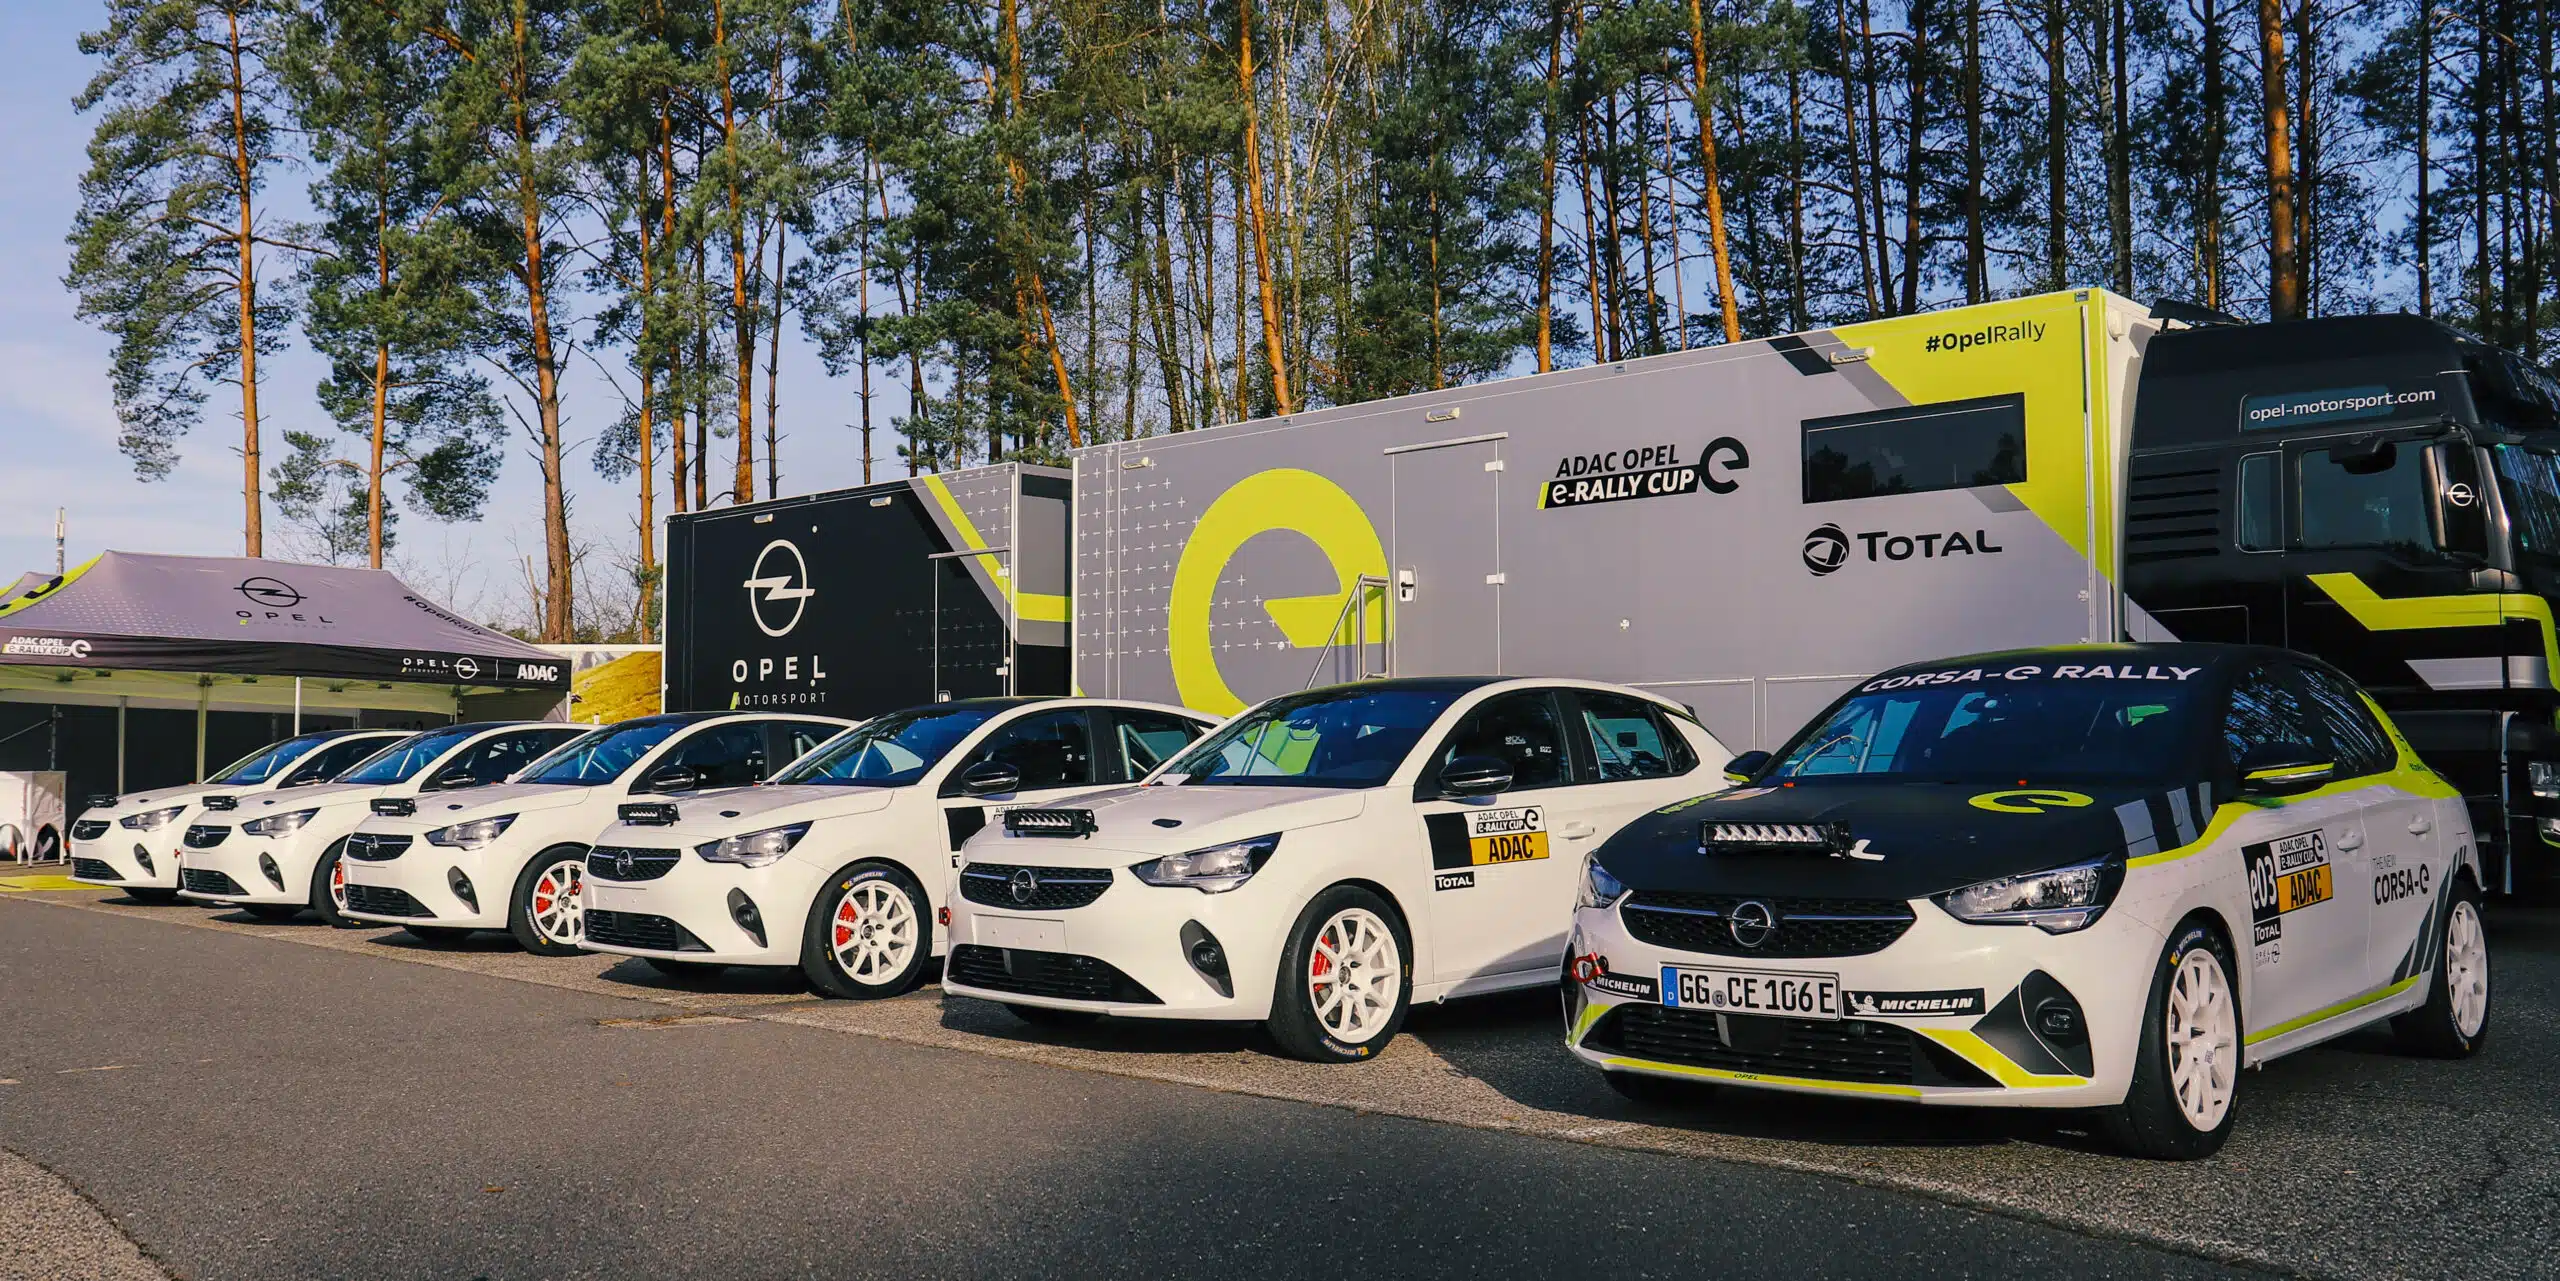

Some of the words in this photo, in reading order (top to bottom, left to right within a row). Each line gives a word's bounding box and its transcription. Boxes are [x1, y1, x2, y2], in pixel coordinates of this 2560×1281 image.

[1925, 320, 2046, 353] #OpelRally
[2249, 389, 2436, 422] opel-motorsport.com
[1556, 452, 1617, 478] ADAC
[1623, 444, 1680, 470] OPEL
[1552, 474, 1644, 504] e-RALLY
[1647, 469, 1695, 493] CUP
[1857, 529, 2003, 562] TOTAL
[236, 610, 333, 624] OPEL
[10, 636, 39, 645] ADAC
[39, 637, 65, 646] OPEL
[50, 647, 69, 655] CUP
[402, 657, 449, 668] OPEL
[517, 664, 558, 681] ADAC
[732, 655, 826, 682] OPEL
[1862, 666, 2042, 692] CORSA-e
[2052, 665, 2202, 681] RALLY
[1478, 812, 1498, 821] ADAC
[1500, 810, 1519, 820] OPEL
[1477, 821, 1508, 833] e-RALLY
[1509, 820, 1524, 830] CUP
[1489, 834, 1534, 862] ADAC
[2279, 838, 2296, 853] ADAC
[2296, 836, 2309, 850] OPEL
[2281, 850, 2303, 868] e-RALLY
[2303, 848, 2314, 863] CUP
[1436, 875, 1473, 889] TOTAL
[2250, 856, 2278, 910] e03
[2290, 869, 2322, 908] ADAC
[2374, 863, 2430, 905] CORSA-e
[2255, 924, 2281, 942] TOTAL
[1597, 977, 1651, 994] MICHELIN
[1667, 992, 1674, 1001] D
[1679, 974, 1710, 1004] GG
[1727, 977, 1760, 1008] CE
[1880, 998, 1974, 1010] MICHELIN
